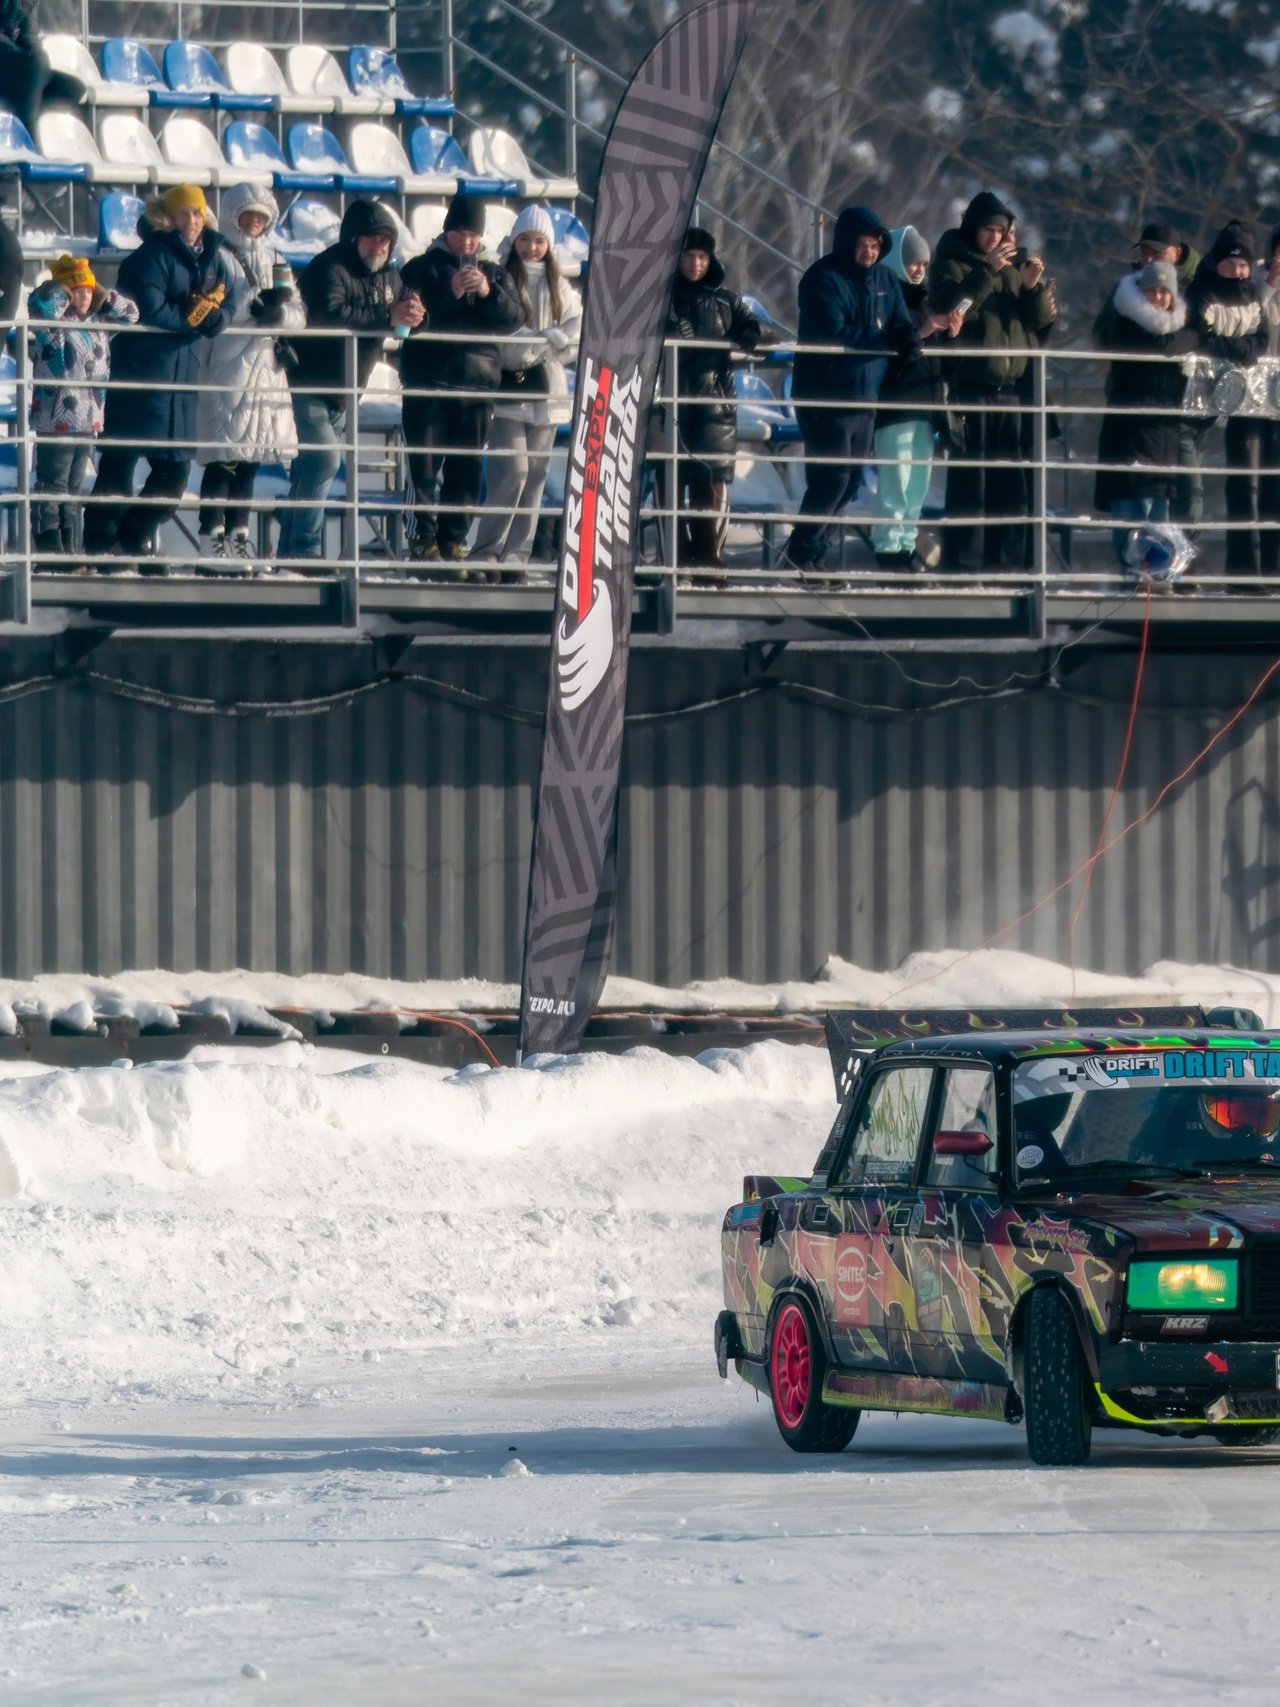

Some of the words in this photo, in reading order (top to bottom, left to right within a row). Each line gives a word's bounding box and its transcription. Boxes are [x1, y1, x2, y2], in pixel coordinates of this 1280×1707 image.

[585, 391, 606, 493] EXPO
[562, 357, 599, 611] DRIFT
[594, 372, 632, 570] TRACK
[1106, 1056, 1158, 1070] DRIFT
[1164, 1051, 1248, 1078] DRIFT
[837, 1266, 865, 1282] SINTEC
[1165, 1317, 1207, 1329] KRZ
